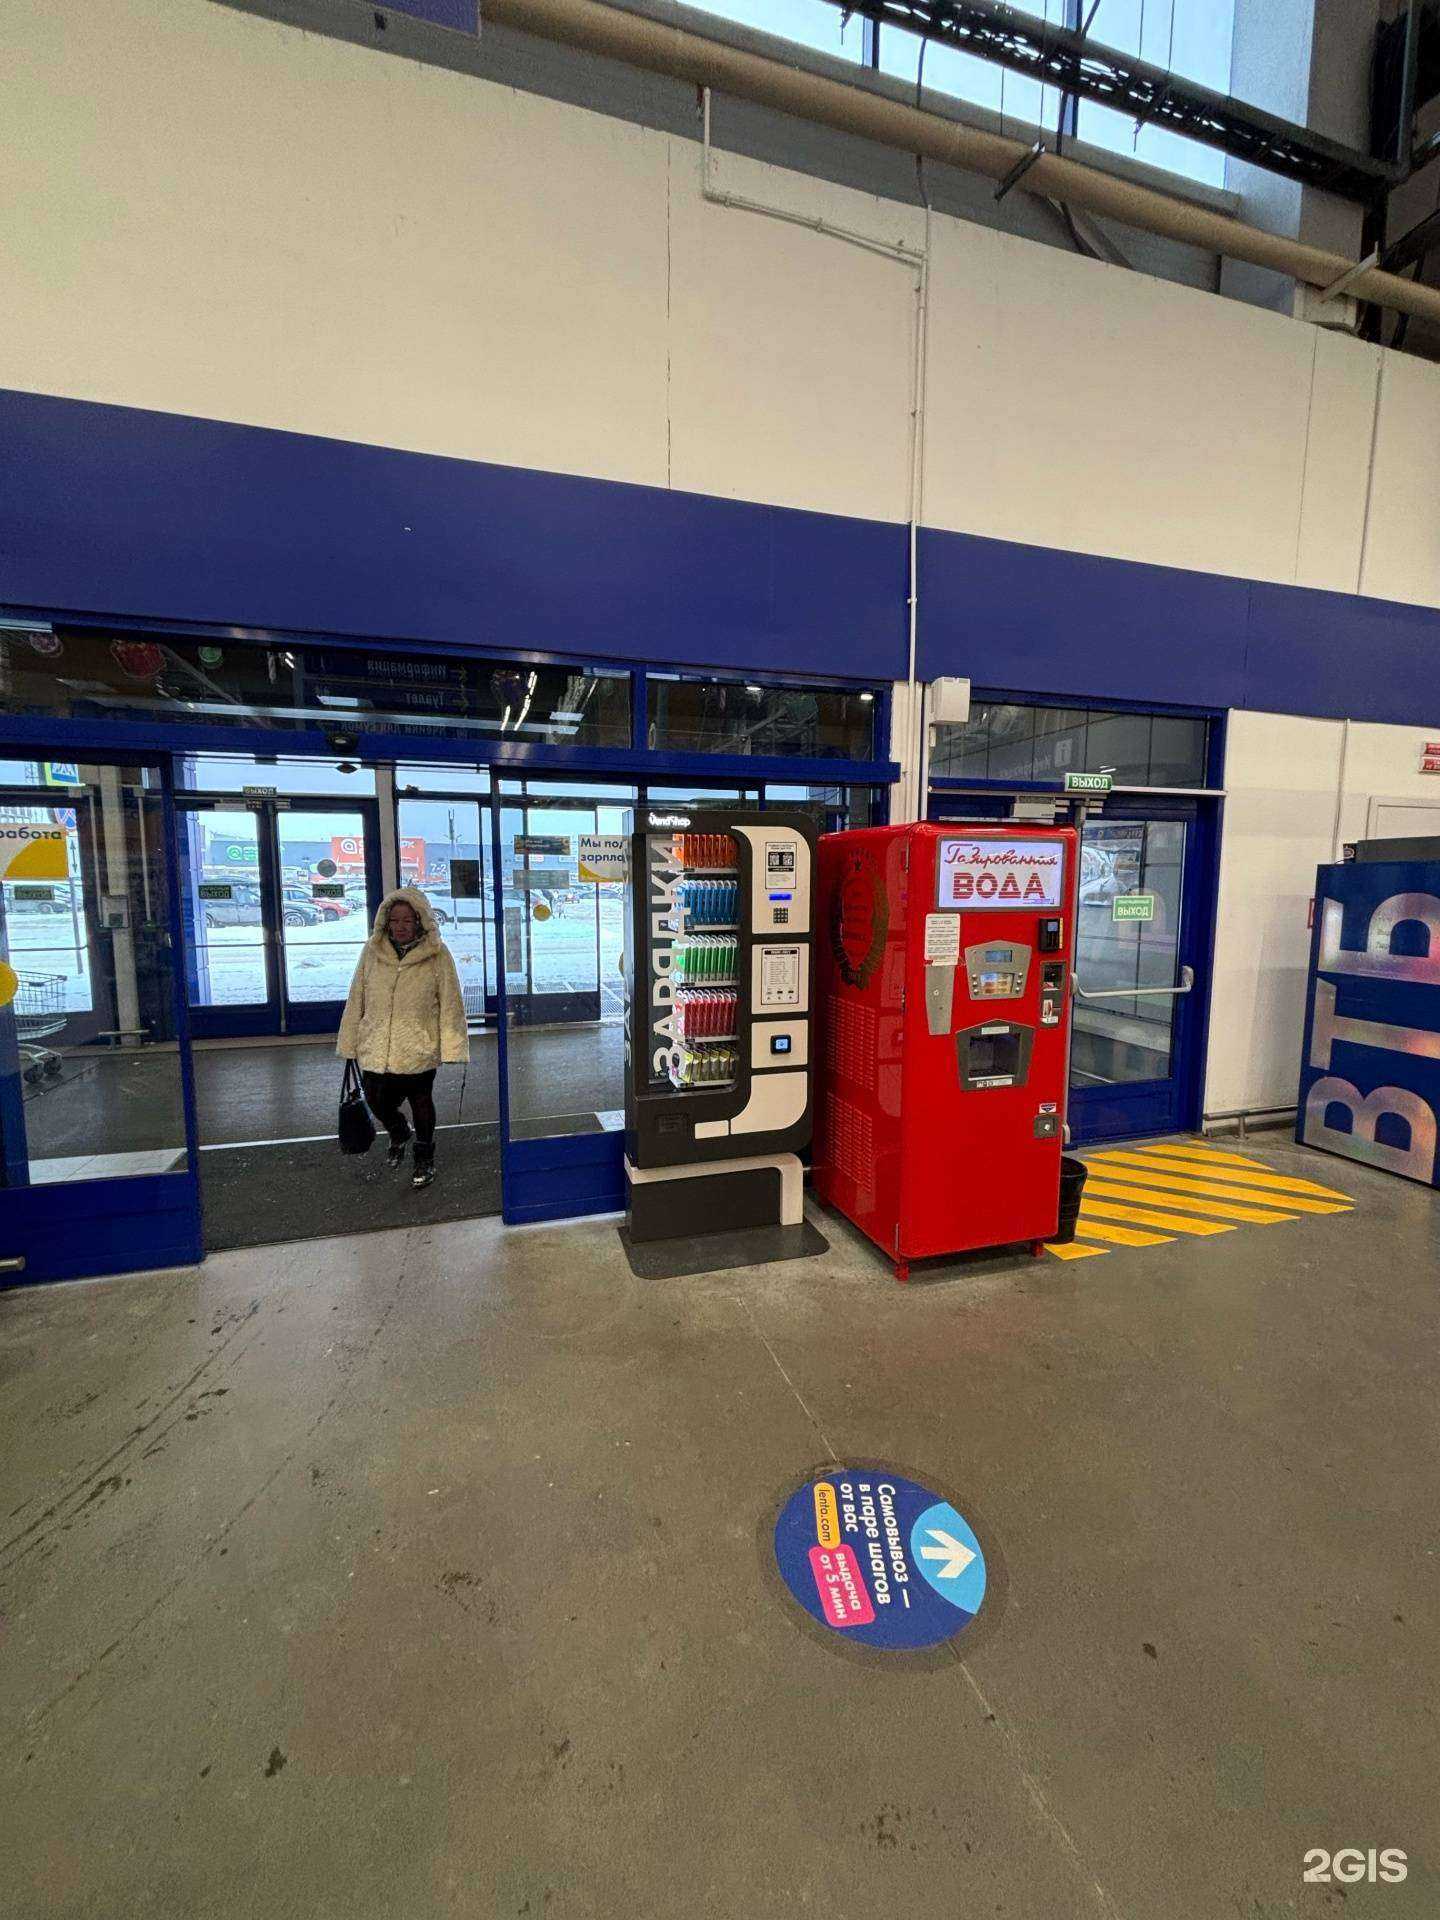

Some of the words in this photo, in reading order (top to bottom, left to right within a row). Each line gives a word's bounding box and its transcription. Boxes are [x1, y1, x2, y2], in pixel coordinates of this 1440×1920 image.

[1072, 776, 1108, 790] ВЫХОД
[581, 838, 601, 848] Мы
[944, 843, 1058, 869] Газированная
[952, 872, 1046, 900] ВОДА
[1118, 906, 1149, 917] ВЫХОД
[651, 835, 692, 1073] ЗАРЯДКИ
[840, 1483, 854, 1501] от
[859, 1484, 871, 1492] в
[818, 1489, 831, 1541] lenta.com
[843, 1504, 858, 1533] вас
[858, 1496, 879, 1538] паре
[878, 1484, 909, 1583] Самовывоз
[820, 1554, 833, 1570] от
[868, 1542, 891, 1605] шагов
[826, 1574, 840, 1583] 5
[836, 1553, 861, 1611] выдача
[828, 1587, 847, 1619] мин
